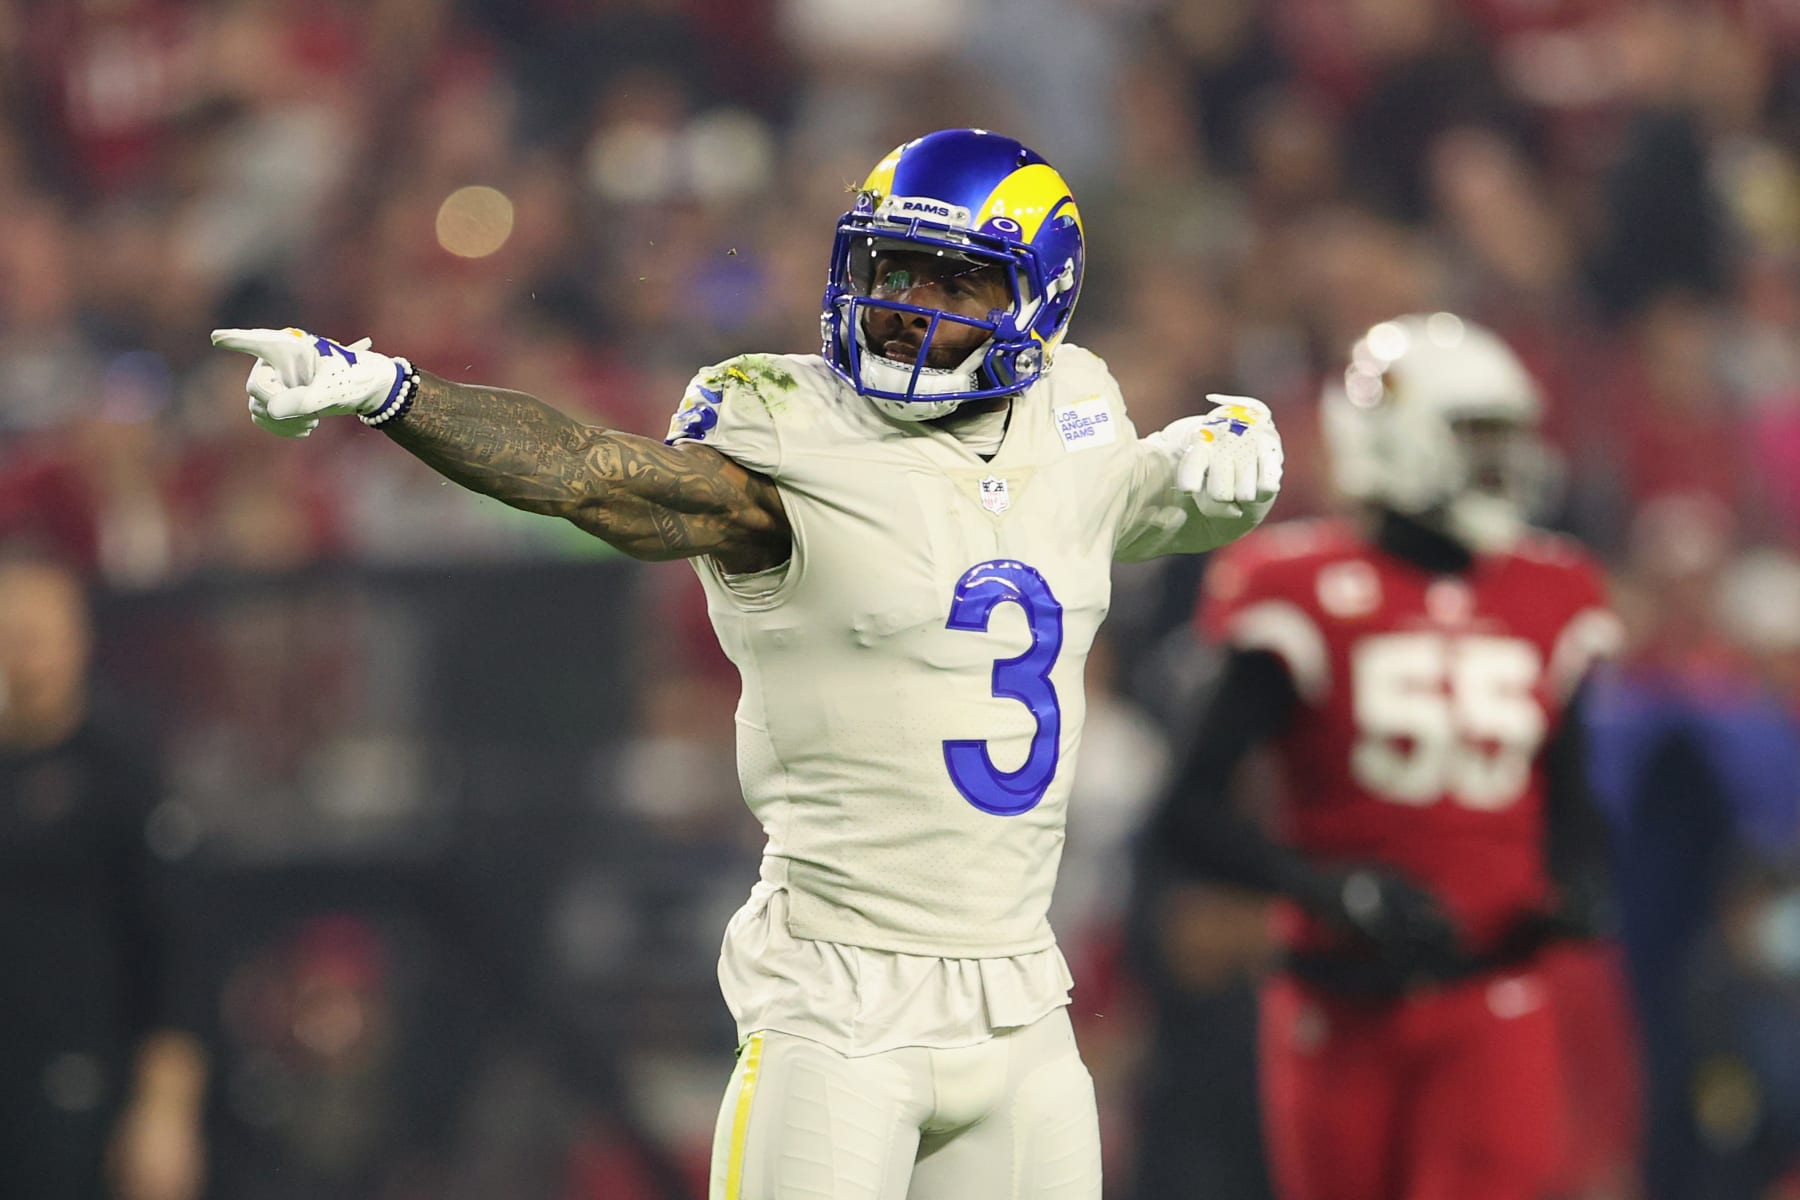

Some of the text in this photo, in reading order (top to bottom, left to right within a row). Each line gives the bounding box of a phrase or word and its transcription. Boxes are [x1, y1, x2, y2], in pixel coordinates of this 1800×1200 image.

[903, 202, 949, 217] RAMS
[1057, 410, 1078, 423] LOS
[1062, 412, 1109, 432] ANGELES
[1064, 426, 1095, 441] RAMS
[942, 559, 1063, 817] 3
[1349, 630, 1548, 812] 55
